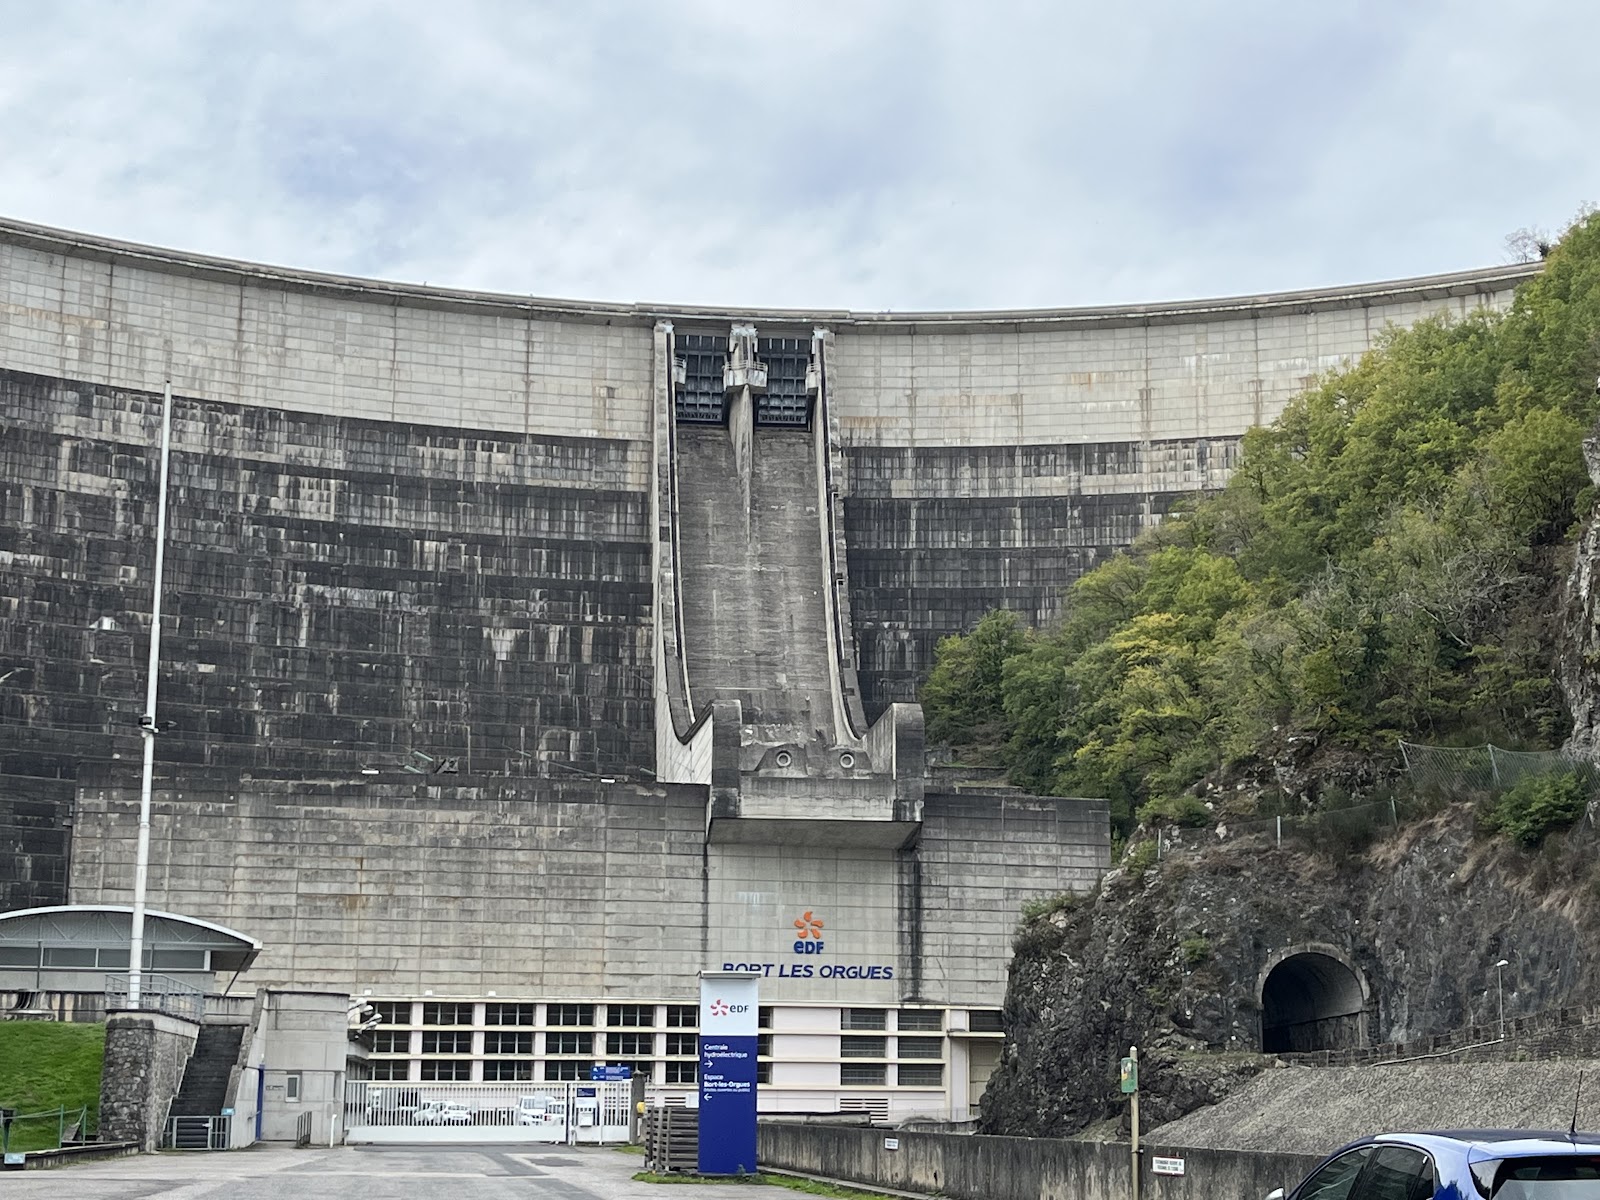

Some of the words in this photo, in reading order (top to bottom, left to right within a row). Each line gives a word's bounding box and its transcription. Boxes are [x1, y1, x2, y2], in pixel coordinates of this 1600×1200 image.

[778, 964, 814, 978] LES
[819, 965, 893, 980] ORGUES
[703, 1043, 729, 1051] Centrale
[703, 1073, 724, 1081] Espace
[703, 1080, 751, 1089] Bort-les-Orgues
